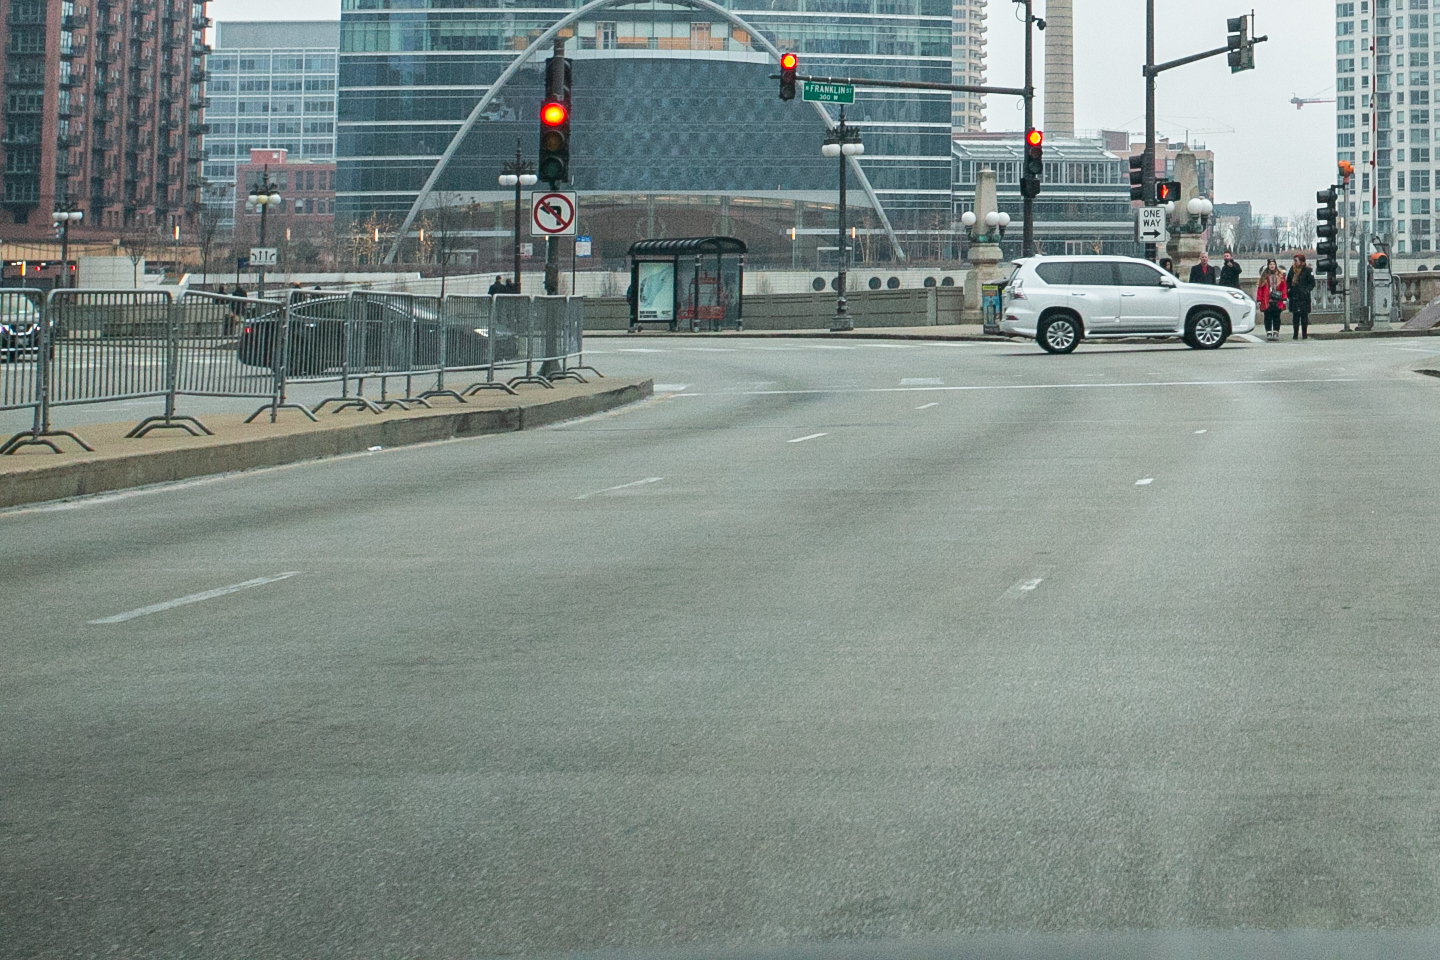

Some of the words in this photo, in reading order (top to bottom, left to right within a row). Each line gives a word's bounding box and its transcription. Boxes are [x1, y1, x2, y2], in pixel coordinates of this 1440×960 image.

[810, 85, 845, 94] FRANKLIN
[1143, 210, 1161, 218] ONE
[1143, 219, 1161, 227] WAY
